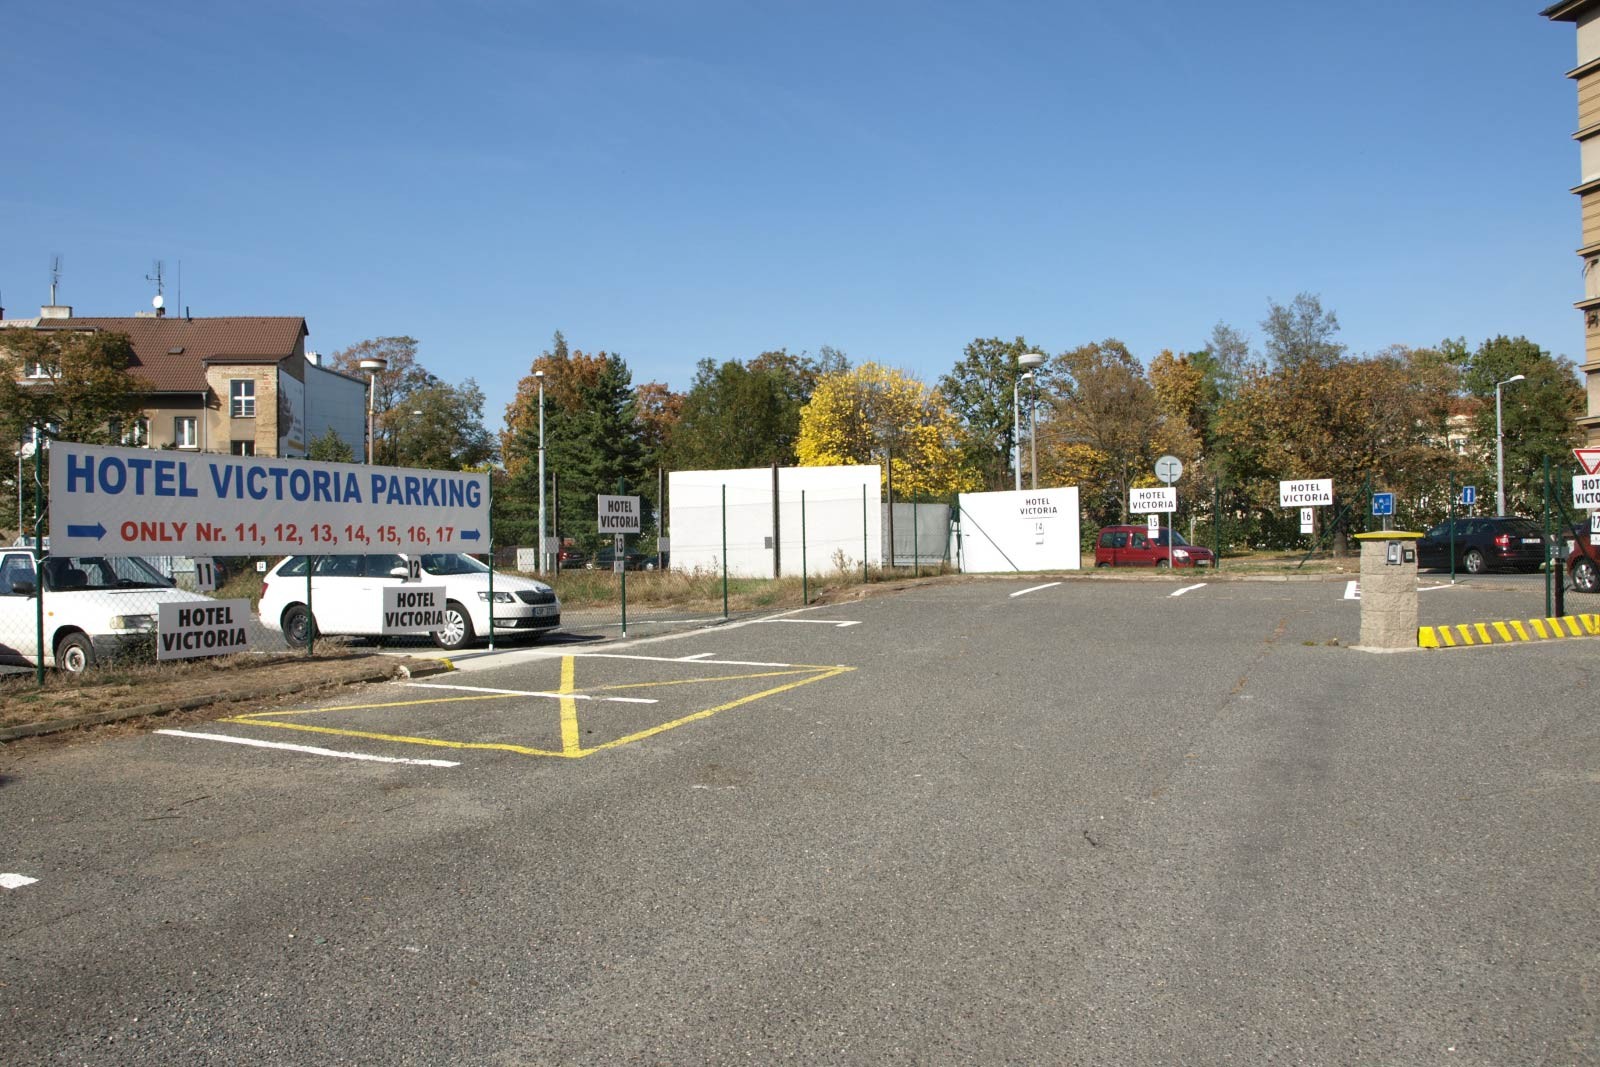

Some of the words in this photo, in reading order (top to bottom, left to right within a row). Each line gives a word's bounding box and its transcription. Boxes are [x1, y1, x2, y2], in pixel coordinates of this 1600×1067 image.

[67, 454, 198, 497] HOTEL
[209, 464, 362, 503] VICTORIA
[371, 474, 481, 508] PARKING
[1290, 483, 1321, 492] HOTEL
[1025, 498, 1050, 506] HOTEL
[1139, 491, 1166, 500] HOTEL
[1283, 493, 1330, 502] VICTORIA
[607, 500, 633, 513] HOTEL
[1019, 506, 1058, 515] VICTORIA
[1132, 500, 1174, 509] VICTORIA
[600, 515, 639, 528] VICTORIA
[1149, 517, 1158, 527] 15
[1302, 511, 1311, 521] 16
[120, 521, 187, 542] ONLY
[196, 522, 227, 542] Nr.
[235, 523, 266, 546] 11,
[274, 523, 304, 546] 12,
[310, 524, 338, 546] 13,
[344, 524, 370, 545] 14,
[376, 525, 401, 545] 15,
[407, 526, 431, 545] 16,
[435, 526, 454, 542] 17
[615, 538, 624, 553] 13
[196, 563, 212, 585] 11
[408, 560, 420, 579] 12
[397, 592, 435, 608] HOTEL
[178, 607, 233, 627] HOTEL
[385, 610, 444, 627] VICTORIA
[162, 628, 247, 652] VICTORIA
